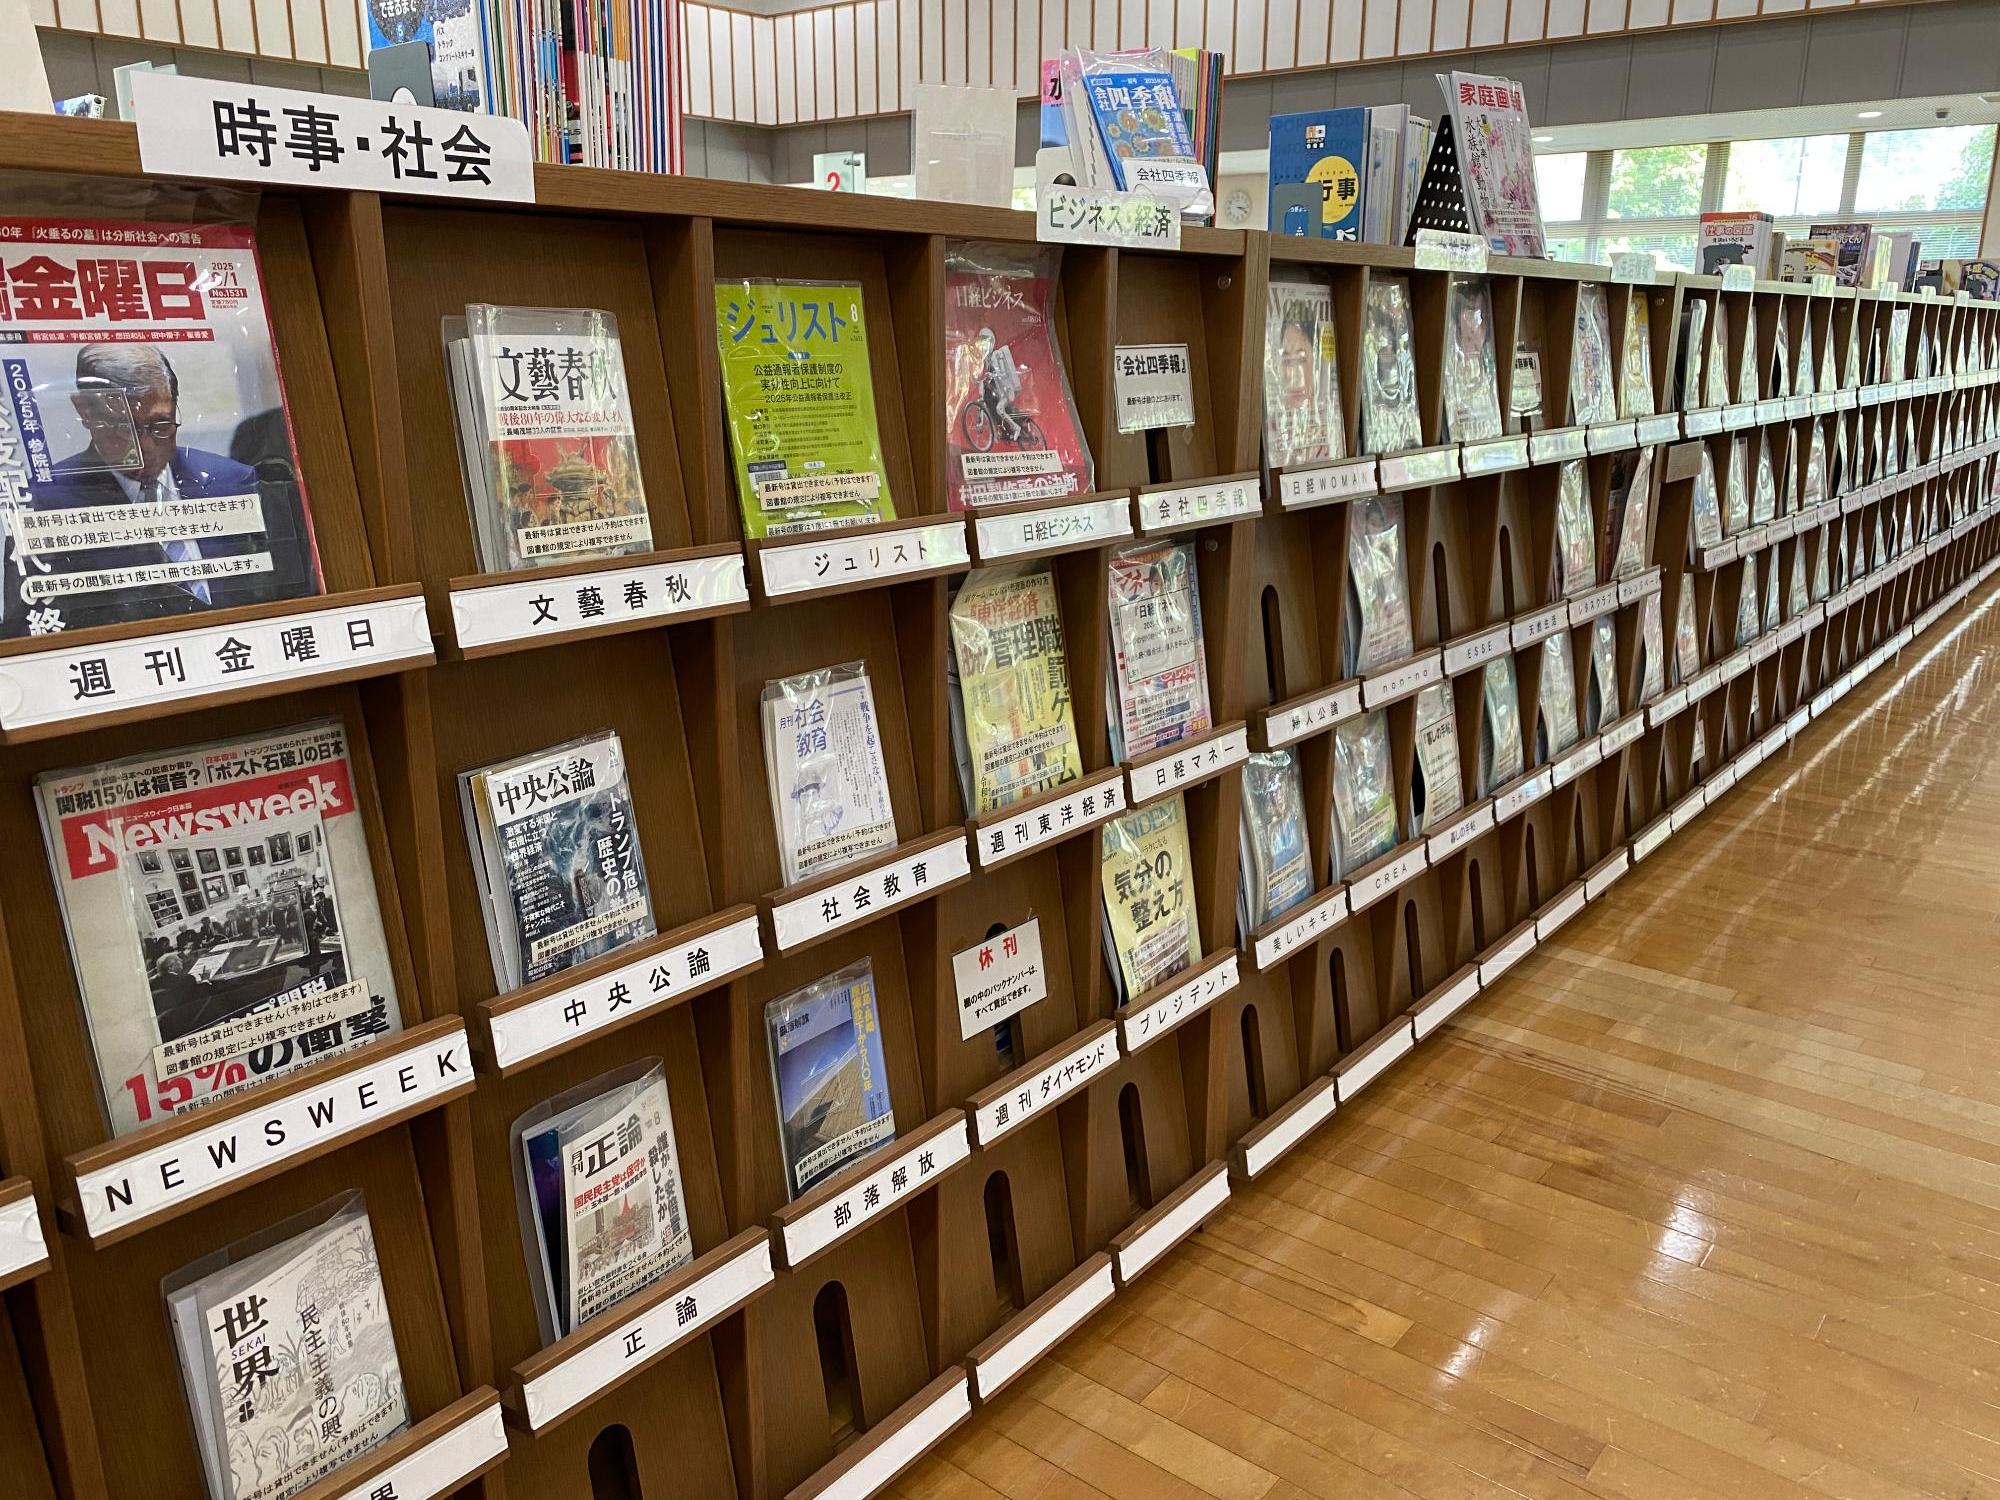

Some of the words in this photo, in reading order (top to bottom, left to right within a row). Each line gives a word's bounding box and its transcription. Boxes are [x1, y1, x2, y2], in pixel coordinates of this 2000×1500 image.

[1459, 82, 1522, 113] 家庭画報
[213, 98, 491, 186] 時事・社会
[1137, 167, 1200, 184] 会社四季報
[1050, 195, 1172, 238] ビジネス・経済
[211, 262, 234, 271] 2025
[212, 289, 244, 298] No.1531
[850, 303, 859, 322] 8
[955, 285, 1025, 311] 日経ビジネス
[727, 300, 846, 343] ジュリスト
[492, 346, 618, 402] 文藝春秋
[1116, 354, 1187, 376] 『会社四季報』
[1159, 488, 1245, 520] 会社四季報
[1293, 472, 1368, 496] 日経WOMAN
[1023, 515, 1094, 543] 日経ビジネス
[814, 541, 927, 577] ジュリスト
[529, 574, 691, 626] 文藝春秋
[69, 618, 375, 701] 週刊金曜日
[1466, 640, 1494, 660] ESSE
[1382, 668, 1429, 694] non-no
[794, 698, 825, 729] 社会
[1291, 700, 1340, 732] 婦人公論
[206, 740, 344, 784] 「ポスト石破」の日本
[796, 726, 828, 758] 教育
[496, 757, 597, 816] 中央公論
[1155, 745, 1235, 787] 日経マネー
[82, 775, 344, 866] Newsweek
[991, 788, 1116, 854] 週刊東洋経済
[822, 862, 928, 923] 社会教育
[1113, 849, 1173, 905] 気分の
[1375, 863, 1408, 889] CREA
[1129, 878, 1185, 934] 整え方
[1272, 903, 1338, 954] 美しいキモノ
[979, 933, 1018, 971] 休刊
[564, 948, 711, 1027] 中央公論
[1140, 970, 1229, 1035] プレジデント
[166, 1012, 336, 1076] 図書館の規定により複写できません
[996, 1044, 1105, 1128] 週刊ダイヤモンド
[105, 1050, 458, 1212] NEWSWEEK
[653, 1111, 661, 1125] 8
[571, 1149, 584, 1177] 月刊
[584, 1113, 643, 1179] 正論
[833, 1150, 936, 1230] 部落解放
[213, 1294, 281, 1401] 世界
[231, 1332, 268, 1360] SEKAI
[624, 1295, 698, 1359] 正論
[300, 1303, 342, 1444] 民主主義の興
[238, 1400, 256, 1425] 8
